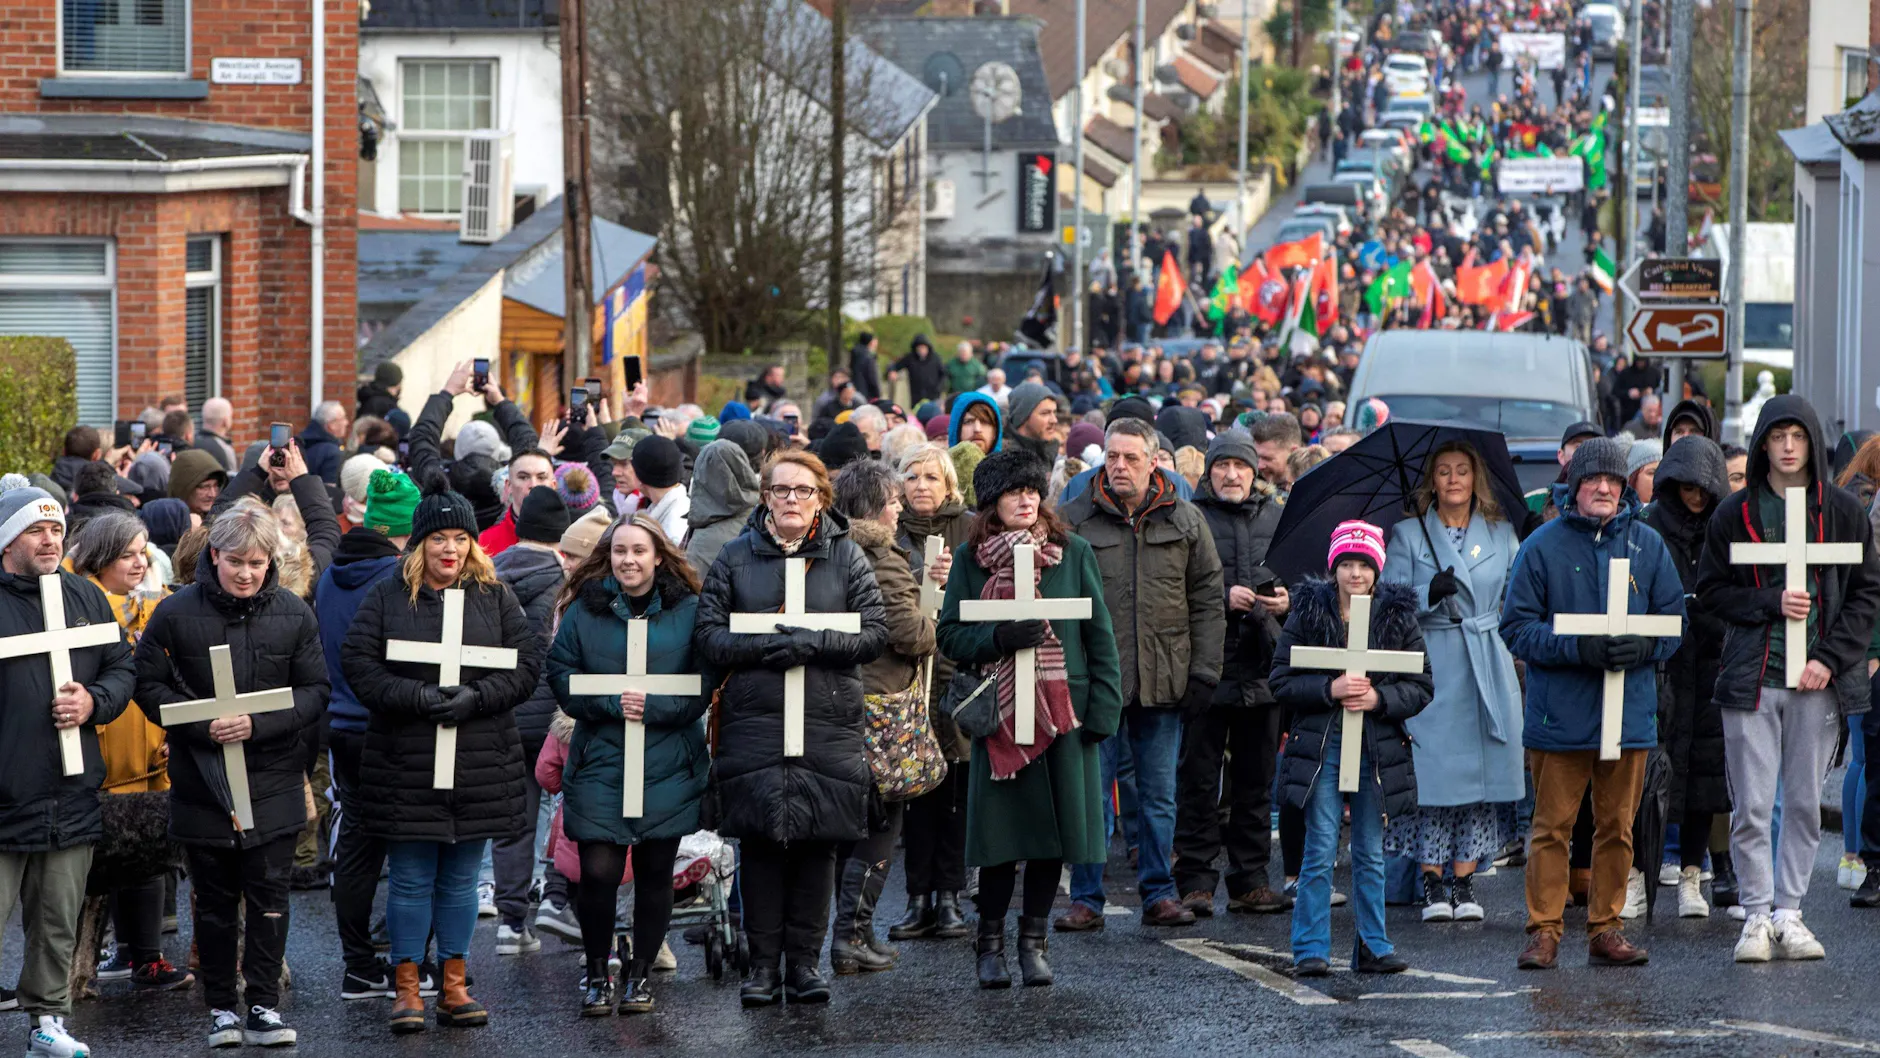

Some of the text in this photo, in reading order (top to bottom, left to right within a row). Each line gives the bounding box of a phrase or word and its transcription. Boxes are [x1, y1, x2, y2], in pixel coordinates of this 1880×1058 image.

[1644, 262, 1713, 278] Cathedral View
[1649, 283, 1664, 291] BED
[1671, 283, 1712, 291] BREAKFAST
